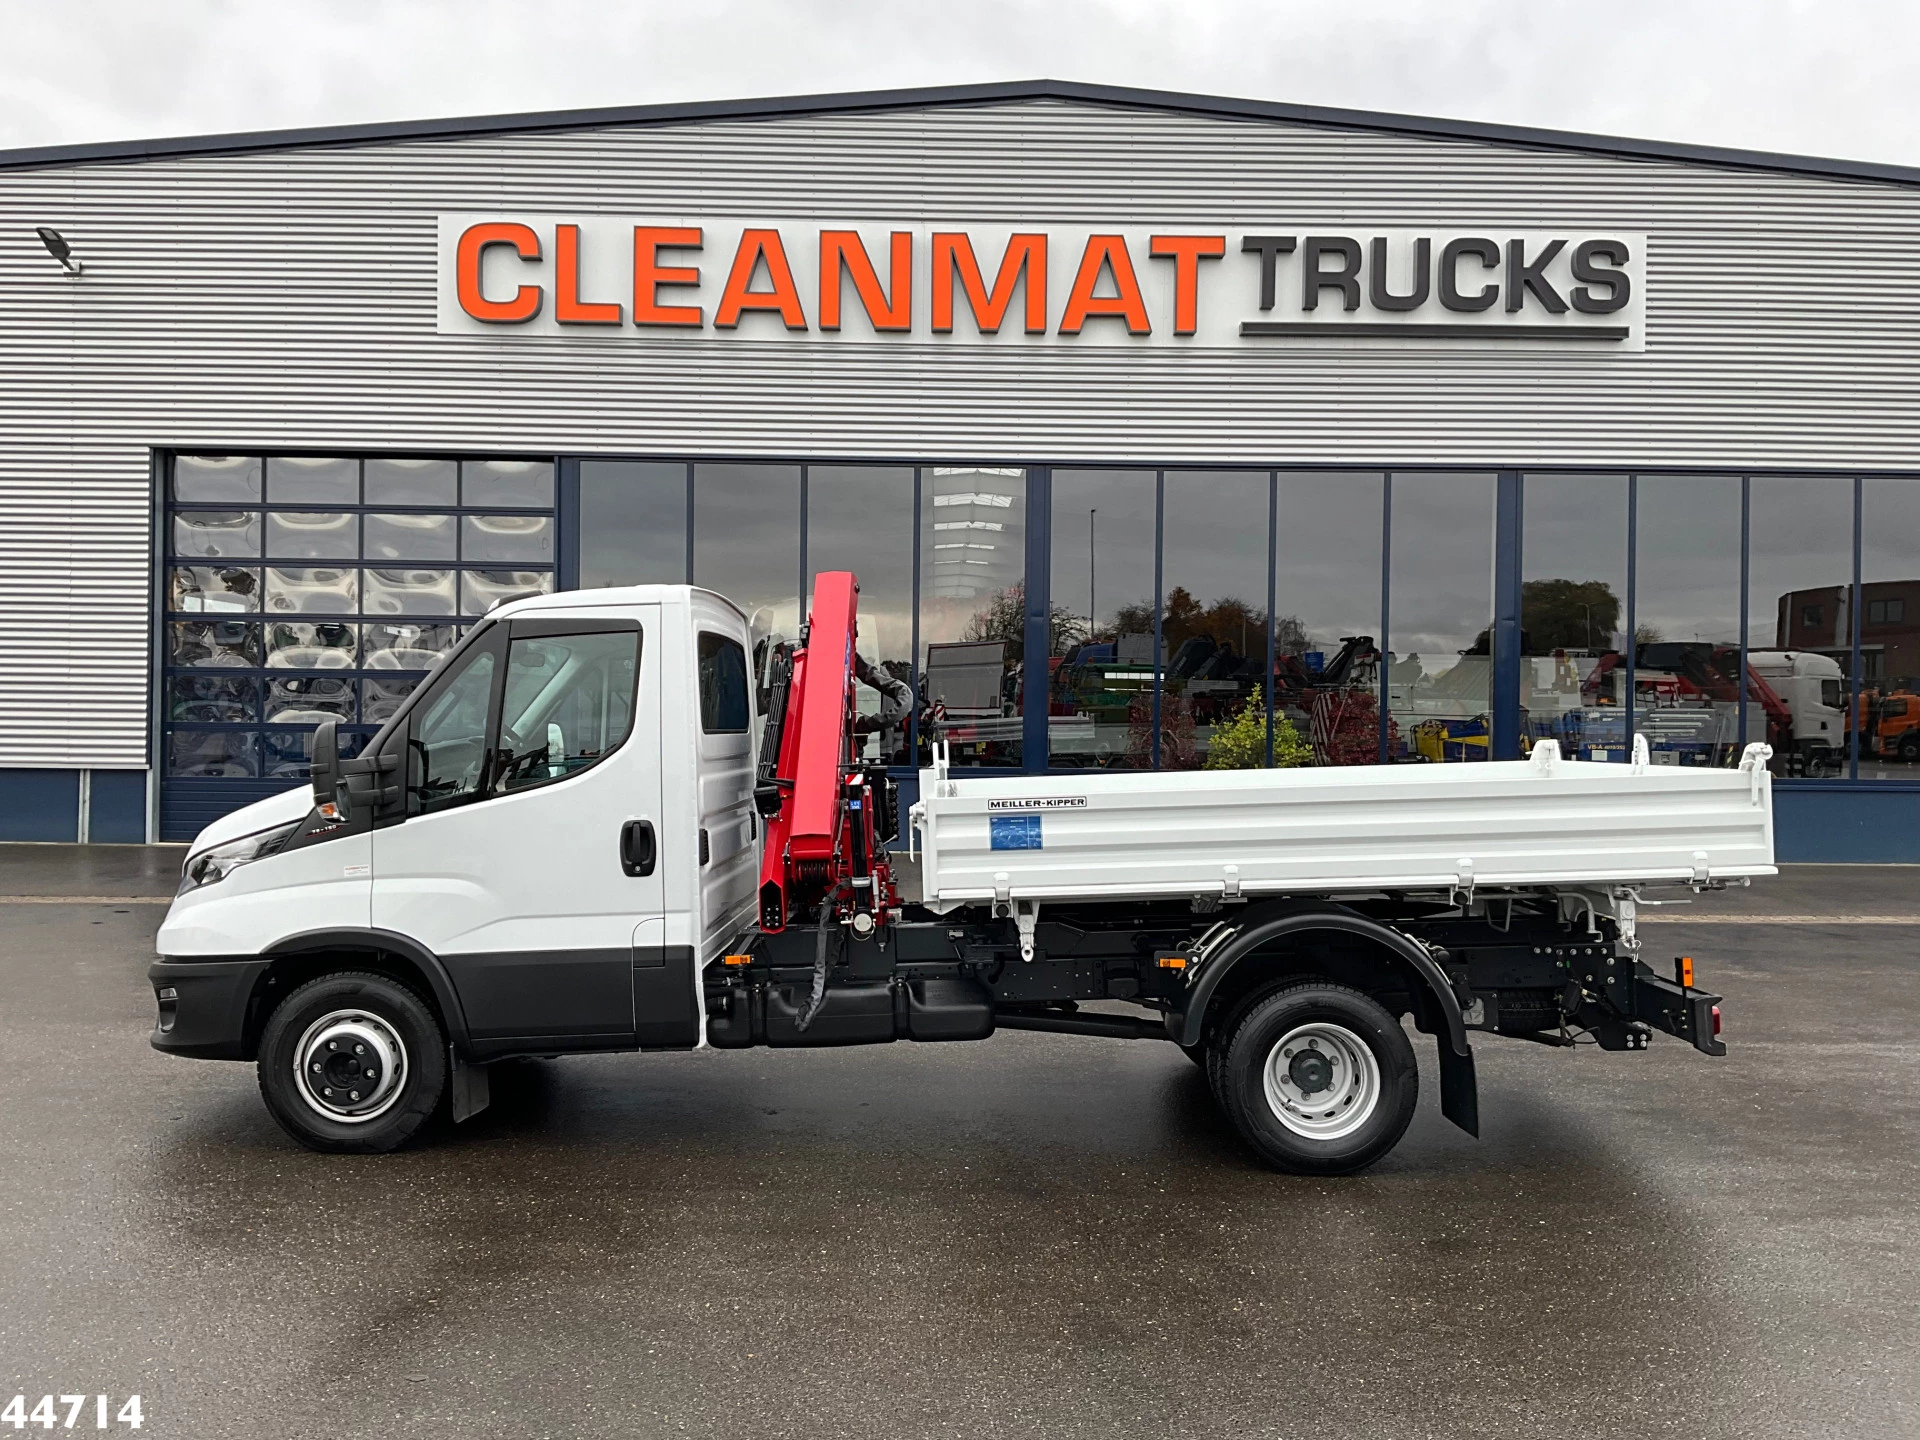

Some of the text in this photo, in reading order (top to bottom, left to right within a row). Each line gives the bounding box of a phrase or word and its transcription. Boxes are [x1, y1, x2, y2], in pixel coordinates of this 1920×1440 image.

[456, 222, 1631, 335] CLEANMAT TRUCKS
[990, 799, 1085, 808] MEILLER-KIPPER
